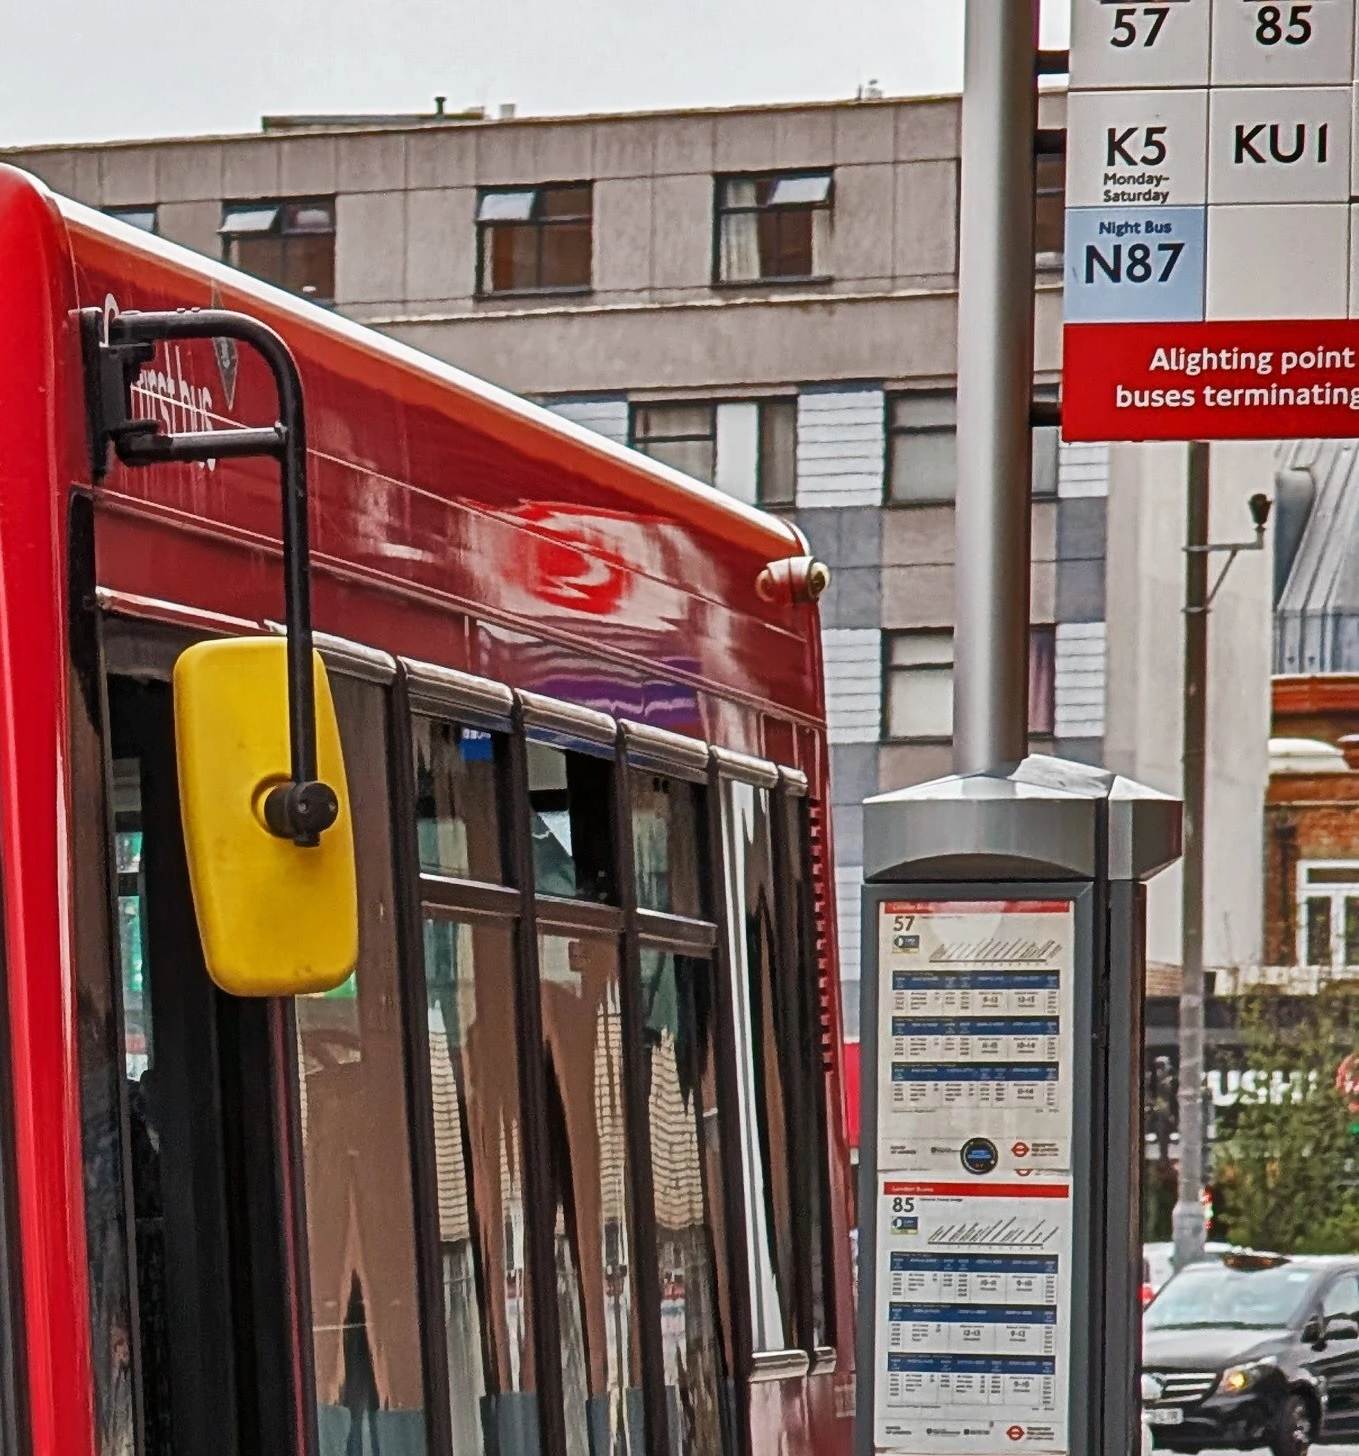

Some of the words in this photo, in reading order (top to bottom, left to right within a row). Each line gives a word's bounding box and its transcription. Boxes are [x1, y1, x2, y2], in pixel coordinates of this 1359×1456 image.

[1109, 6, 1170, 49] 57
[1255, 4, 1313, 46] 85
[1106, 126, 1168, 167] K5
[1234, 123, 1329, 164] KU1
[1103, 172, 1170, 187] Monday-
[1103, 189, 1170, 204] Saturday
[1098, 221, 1142, 237] Night
[1144, 220, 1173, 234] Bus
[1084, 242, 1186, 284] N87
[1149, 347, 1274, 376] Alighting
[1281, 345, 1356, 375] point
[1115, 384, 1196, 408] buses
[1202, 382, 1359, 410] terminating
[892, 915, 916, 932] 57
[1201, 1069, 1319, 1107] USHI
[892, 1196, 915, 1213] 85
